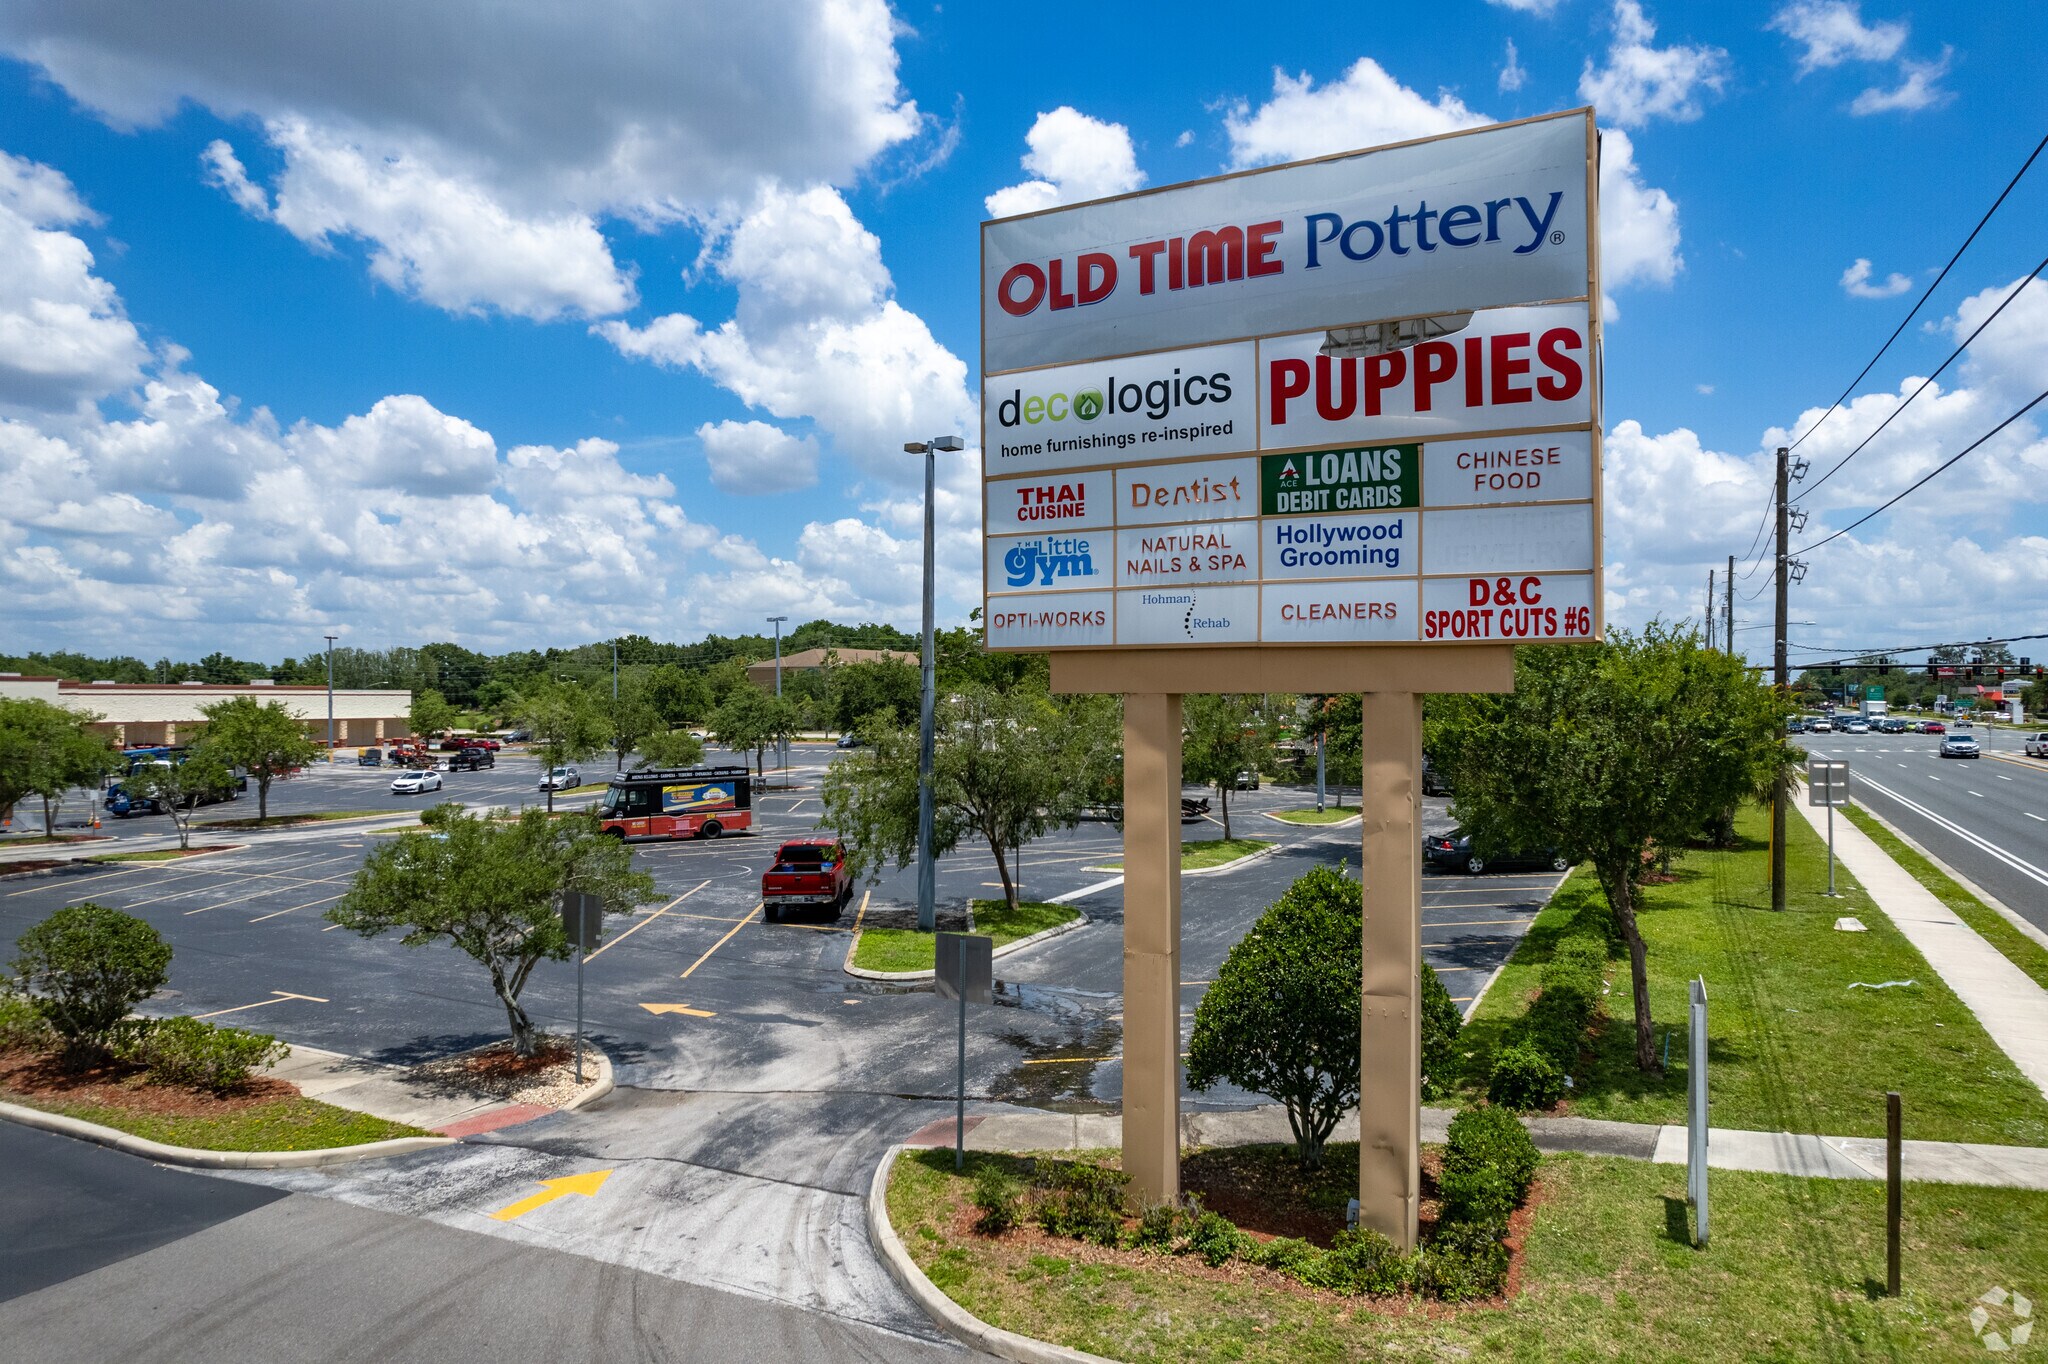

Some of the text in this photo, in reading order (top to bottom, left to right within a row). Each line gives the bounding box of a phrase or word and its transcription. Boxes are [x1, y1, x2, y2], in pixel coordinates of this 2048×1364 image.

[998, 191, 1564, 317] OLD TIME Pottery
[1270, 327, 1583, 425] PUPPIES
[1001, 420, 1233, 458] home furnishings re-inspired
[1305, 449, 1402, 486] LOANS
[1456, 447, 1561, 470] CHINESE
[1131, 475, 1241, 508] Dentist
[1280, 480, 1298, 488] ACE
[1474, 471, 1541, 492] FOOD
[1017, 483, 1085, 506] THAI
[1277, 485, 1402, 513] DEBIT CARDS
[1017, 502, 1085, 521] CUISINE
[1141, 533, 1232, 554] NATURAL
[1276, 519, 1403, 548] Hollywood
[1038, 536, 1090, 555] Little
[1280, 544, 1400, 568] Grooming
[1004, 547, 1094, 587] gym
[1127, 554, 1247, 576] NAILS & SPA
[1142, 594, 1192, 605] Hohman
[1469, 576, 1542, 607] D&C
[993, 611, 1106, 629] OPTI-WORKS
[1193, 617, 1231, 629] Rehab
[1281, 602, 1398, 621] CLEANERS
[1425, 606, 1591, 639] SPORT CUTS #6
